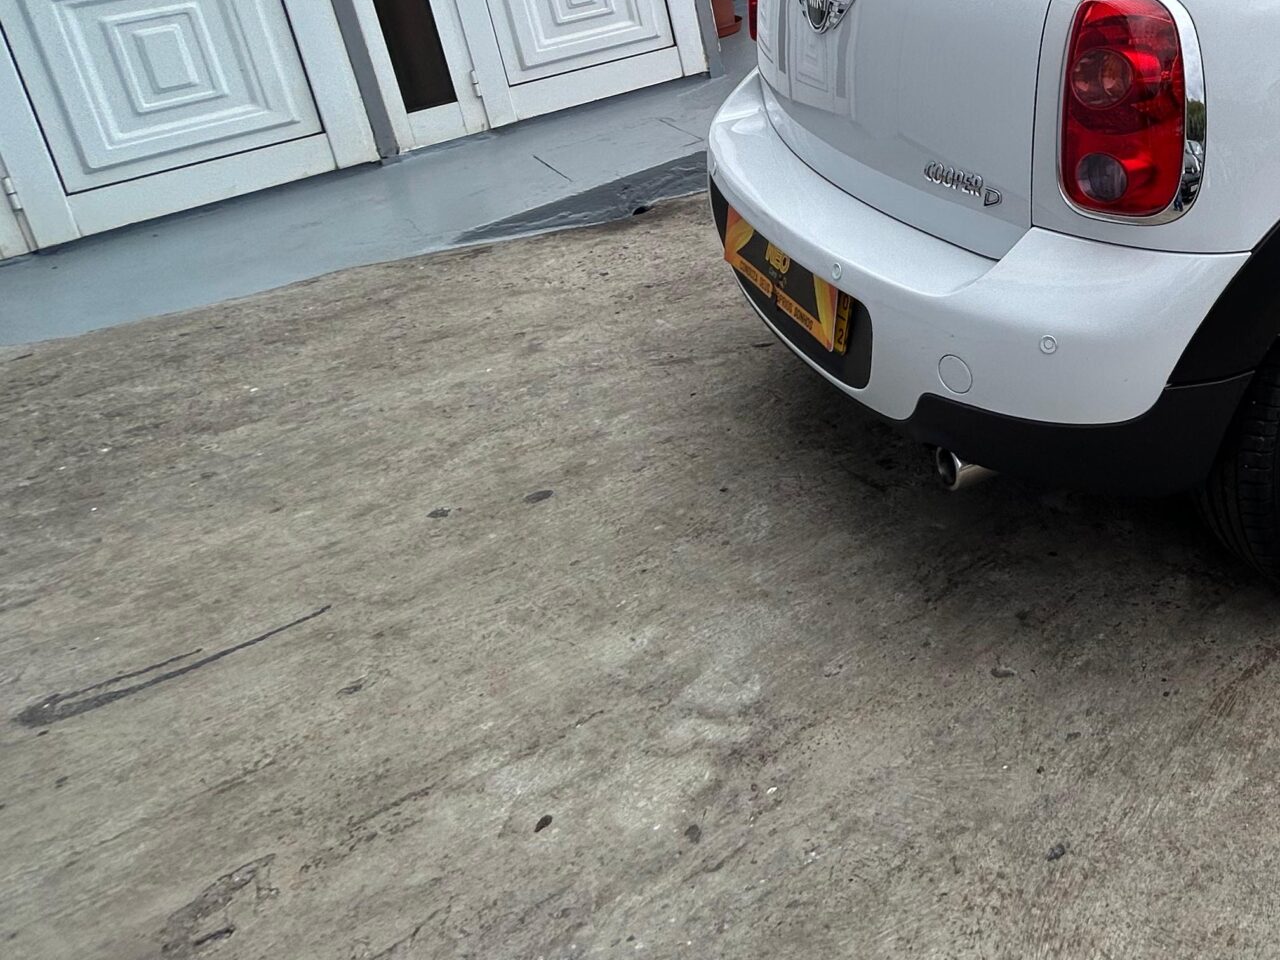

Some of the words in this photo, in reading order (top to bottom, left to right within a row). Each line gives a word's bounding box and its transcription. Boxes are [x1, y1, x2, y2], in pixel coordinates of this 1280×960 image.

[923, 160, 983, 198] COOPER
[983, 186, 1002, 208] D
[765, 241, 791, 274] NEO
